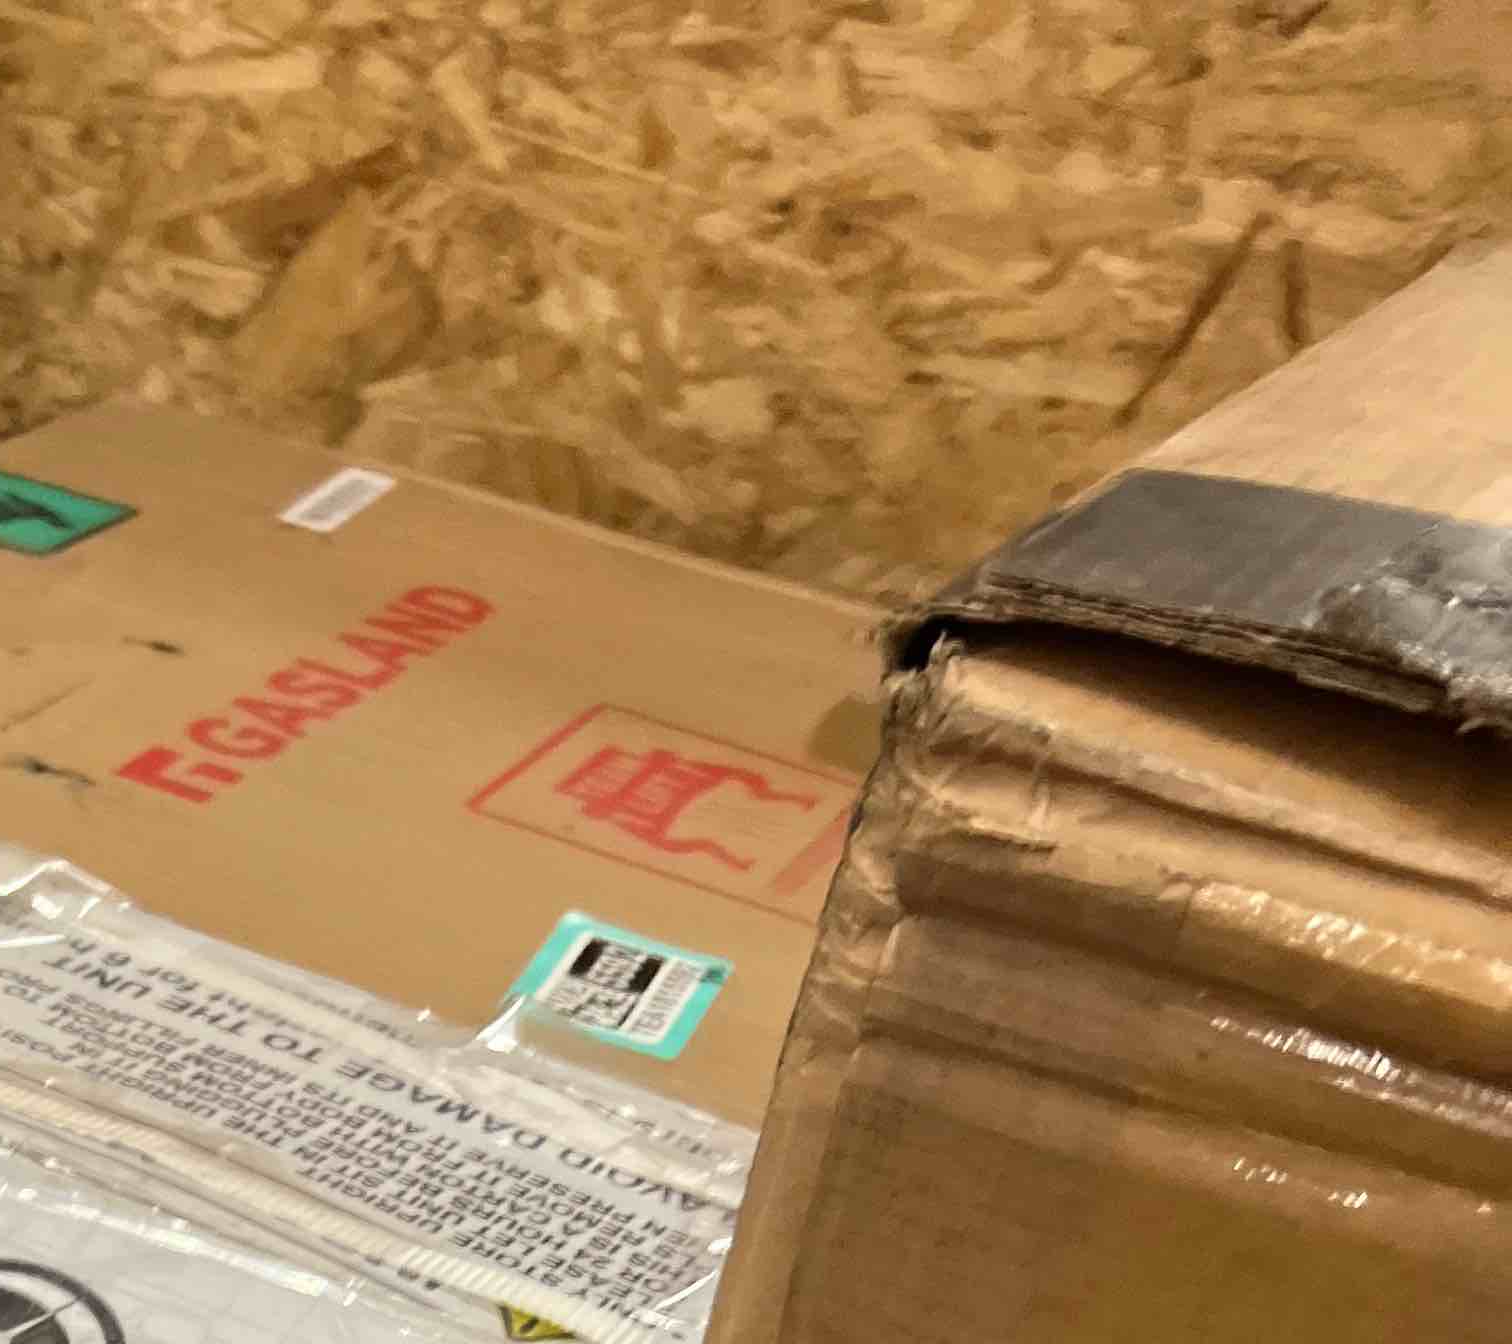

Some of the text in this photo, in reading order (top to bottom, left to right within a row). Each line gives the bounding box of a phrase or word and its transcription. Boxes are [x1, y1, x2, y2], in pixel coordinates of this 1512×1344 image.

[185, 584, 498, 762] GASLAND
[42, 957, 151, 998] UNIT
[48, 1002, 177, 1054] BOTTOM
[159, 999, 247, 1035] THE
[40, 1016, 184, 1072] SUPPORT
[68, 1041, 101, 1058] IN
[262, 1033, 321, 1063] TO
[108, 1057, 138, 1070] IT
[181, 1053, 272, 1090] FROM
[77, 1063, 216, 1118] UPRIGHT
[143, 1069, 305, 1138] PLUGGING
[191, 1072, 323, 1128] BOTTOM
[279, 1090, 366, 1129] BODY
[302, 1081, 352, 1105] ITS
[336, 1065, 546, 1149] DAMAGE
[223, 1117, 283, 1147] THE
[357, 1104, 425, 1133] AND
[291, 1146, 327, 1164] IN
[329, 1127, 409, 1165] WITH
[371, 1128, 463, 1170] FROM
[429, 1134, 459, 1151] IT
[316, 1137, 443, 1197] BEFORE
[334, 1165, 383, 1187] SIT
[473, 1170, 501, 1186] IT
[559, 1147, 708, 1211] AVOID
[298, 1168, 442, 1233] UPRIGHT
[416, 1164, 551, 1224] CARTON
[465, 1151, 635, 1223] PRESERVE
[392, 1189, 465, 1225] UNIT
[451, 1196, 566, 1250] HOURS
[513, 1187, 645, 1245] REMOVE
[473, 1225, 535, 1256] LET
[561, 1223, 581, 1236] A
[588, 1236, 621, 1254] IS
[454, 1236, 561, 1286] STORE
[573, 1248, 610, 1269] 24
